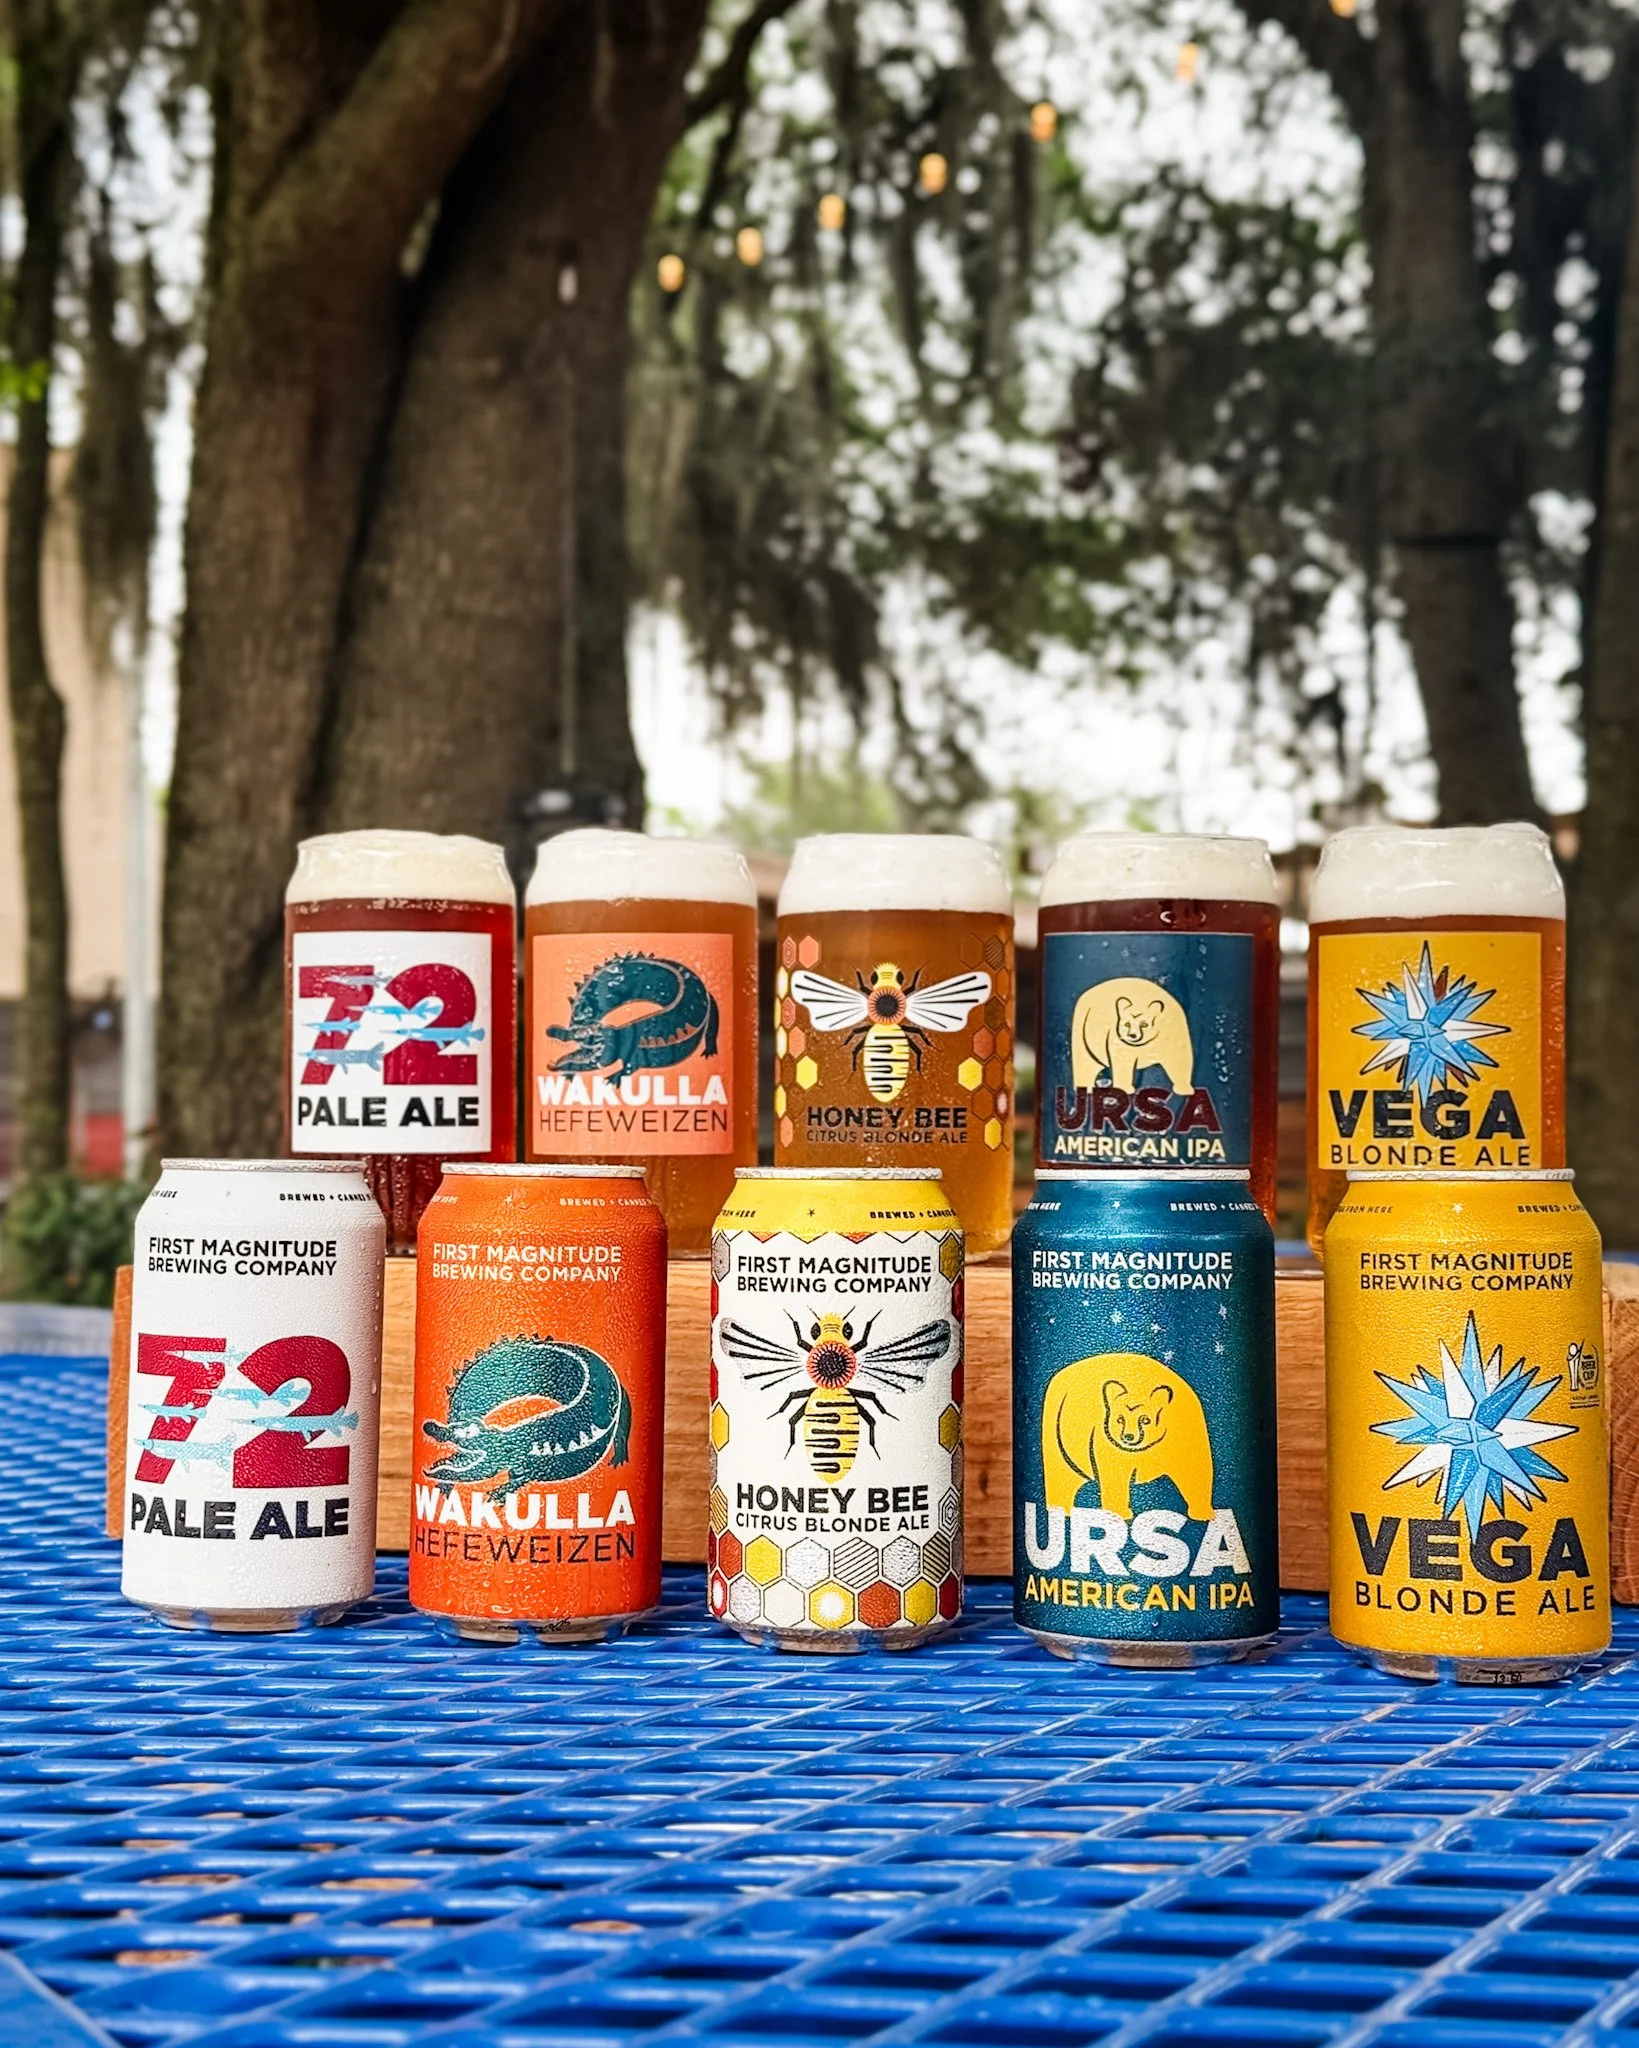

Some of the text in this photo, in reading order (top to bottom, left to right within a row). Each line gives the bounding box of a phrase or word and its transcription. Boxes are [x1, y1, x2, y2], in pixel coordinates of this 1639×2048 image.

[299, 963, 478, 1086] 72
[538, 1075, 728, 1106] WAKULLA
[298, 1096, 479, 1127] PALE ALE
[807, 1106, 968, 1128] HONEY BEE
[1055, 1086, 1226, 1133] URSA
[1328, 1089, 1526, 1140] VEGA
[540, 1109, 727, 1132] HEFEWEIZEN
[807, 1130, 968, 1143] CITRUS BLONDE ALE
[1055, 1134, 1226, 1158] AMERICAN IPA
[1332, 1145, 1530, 1166] BLONDE ALE
[279, 1193, 326, 1201] BREWED
[560, 1198, 606, 1206] BREWED
[1170, 1203, 1218, 1211] BREWED
[869, 1211, 916, 1219] BREWED
[1517, 1205, 1560, 1213] BREWED
[149, 1236, 337, 1257] FIRST MAGNITUDE
[433, 1242, 622, 1263] FIRST MAGNITUDE
[149, 1257, 337, 1276] BREWING COMPANY
[738, 1255, 931, 1274] FIRST MAGNITUDE
[1033, 1251, 1233, 1270] FIRST MAGNITUDE
[1360, 1252, 1573, 1270] FIRST MAGNITUDE
[432, 1263, 622, 1282] BREWING COMPANY
[1032, 1271, 1233, 1290] BREWING COMPANY
[1360, 1274, 1573, 1291] BREWING COMPANY
[737, 1276, 931, 1293] BREWING COMPANY
[135, 1332, 351, 1488] 72
[415, 1483, 636, 1530] WAKULLA
[736, 1483, 929, 1514] HONEY BEE
[131, 1492, 350, 1540] PALE ALE
[736, 1512, 930, 1533] CITRUS BLONDE ALE
[415, 1526, 635, 1563] HEFEWEIZEN
[1024, 1501, 1252, 1577] URSA
[1350, 1511, 1590, 1583] VEGA
[1025, 1574, 1255, 1611] AMERICAN IPA
[1355, 1581, 1595, 1615] BLONDE ALE
